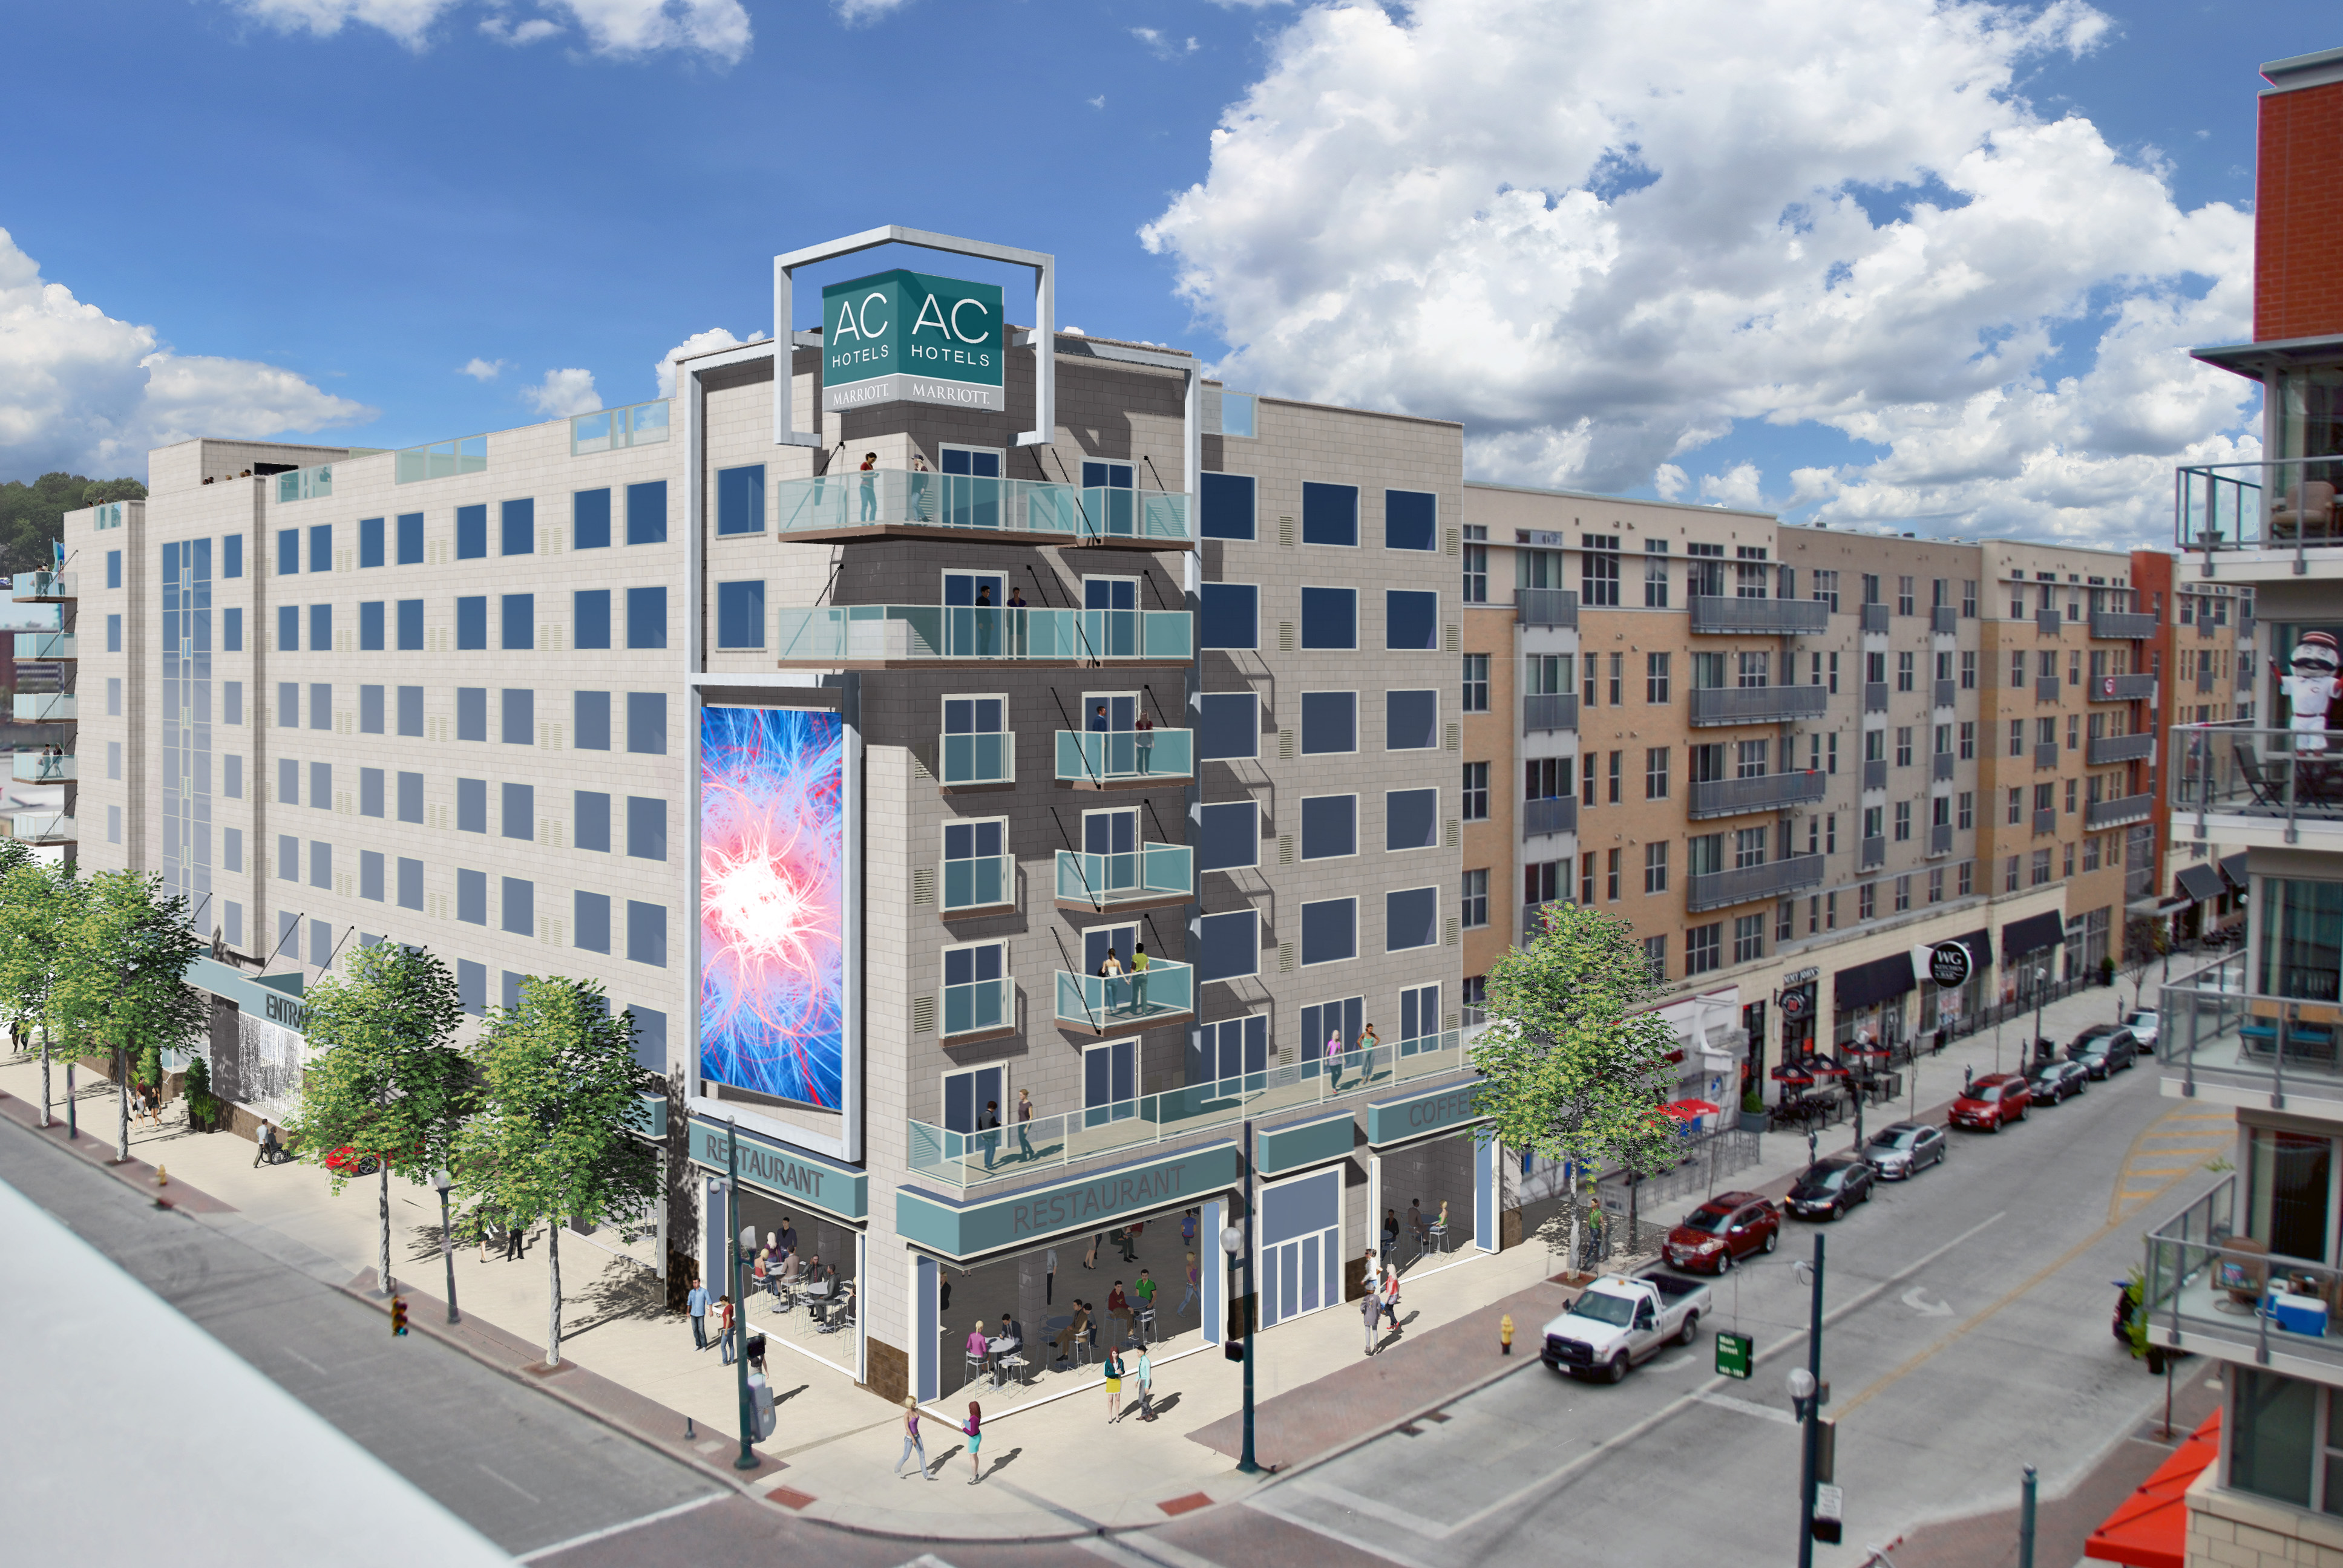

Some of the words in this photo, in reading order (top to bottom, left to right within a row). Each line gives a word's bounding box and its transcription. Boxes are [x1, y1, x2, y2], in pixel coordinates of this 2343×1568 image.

[833, 292, 888, 345] AC
[911, 293, 989, 344] AC
[832, 344, 889, 368] HOTELS
[911, 344, 990, 367] HOTELS
[833, 383, 889, 406] MARRIOTT
[913, 383, 991, 405] MARRIOTT
[1936, 950, 1962, 965] WG
[1409, 1089, 1478, 1127] COFFEE
[706, 1134, 824, 1197] RETAURANT
[1013, 1165, 1185, 1234] RESTAURANT
[1719, 1334, 1735, 1347] Main
[1719, 1344, 1738, 1356] Street
